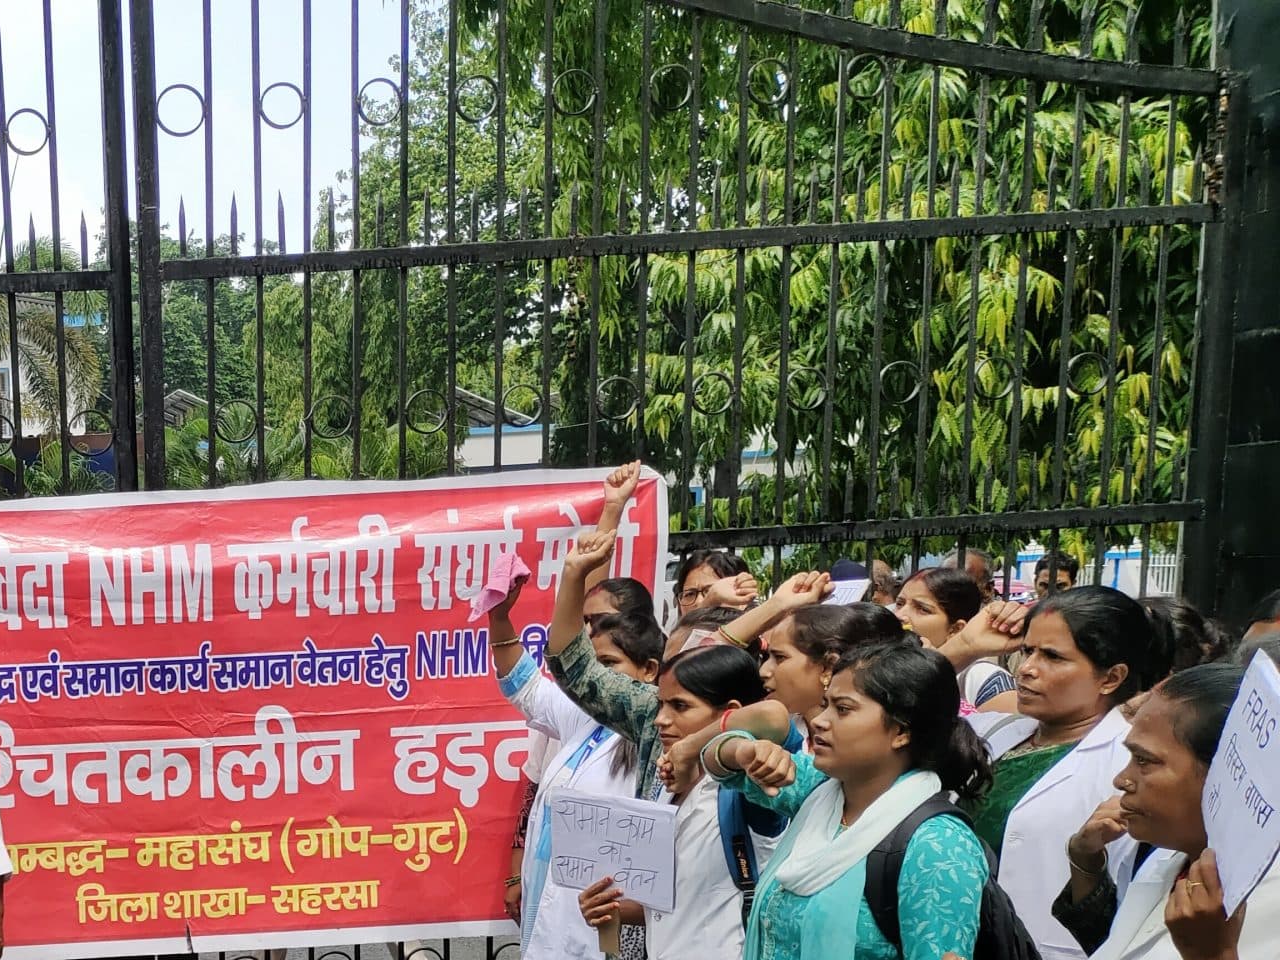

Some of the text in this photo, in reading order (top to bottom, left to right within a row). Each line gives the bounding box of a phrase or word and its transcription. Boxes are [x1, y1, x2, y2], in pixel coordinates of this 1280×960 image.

[88, 543, 214, 628] NHM
[228, 514, 402, 621] कर्मचारी
[22, 651, 59, 701] एवं
[64, 662, 145, 697] समान
[148, 642, 211, 691] कार्य
[213, 654, 294, 690] समान
[297, 637, 362, 684] वेतन
[365, 635, 408, 699] हेतु
[417, 629, 488, 678] NHM
[1242, 688, 1276, 749] FRAS
[556, 800, 656, 846] समान काम
[1244, 779, 1275, 829] वापस
[135, 820, 272, 870] महासंघ
[280, 808, 468, 874] (गोप-गुट)
[76, 880, 380, 924] जिला शाखा- सहरसा
[555, 855, 660, 894] समान वेतन
